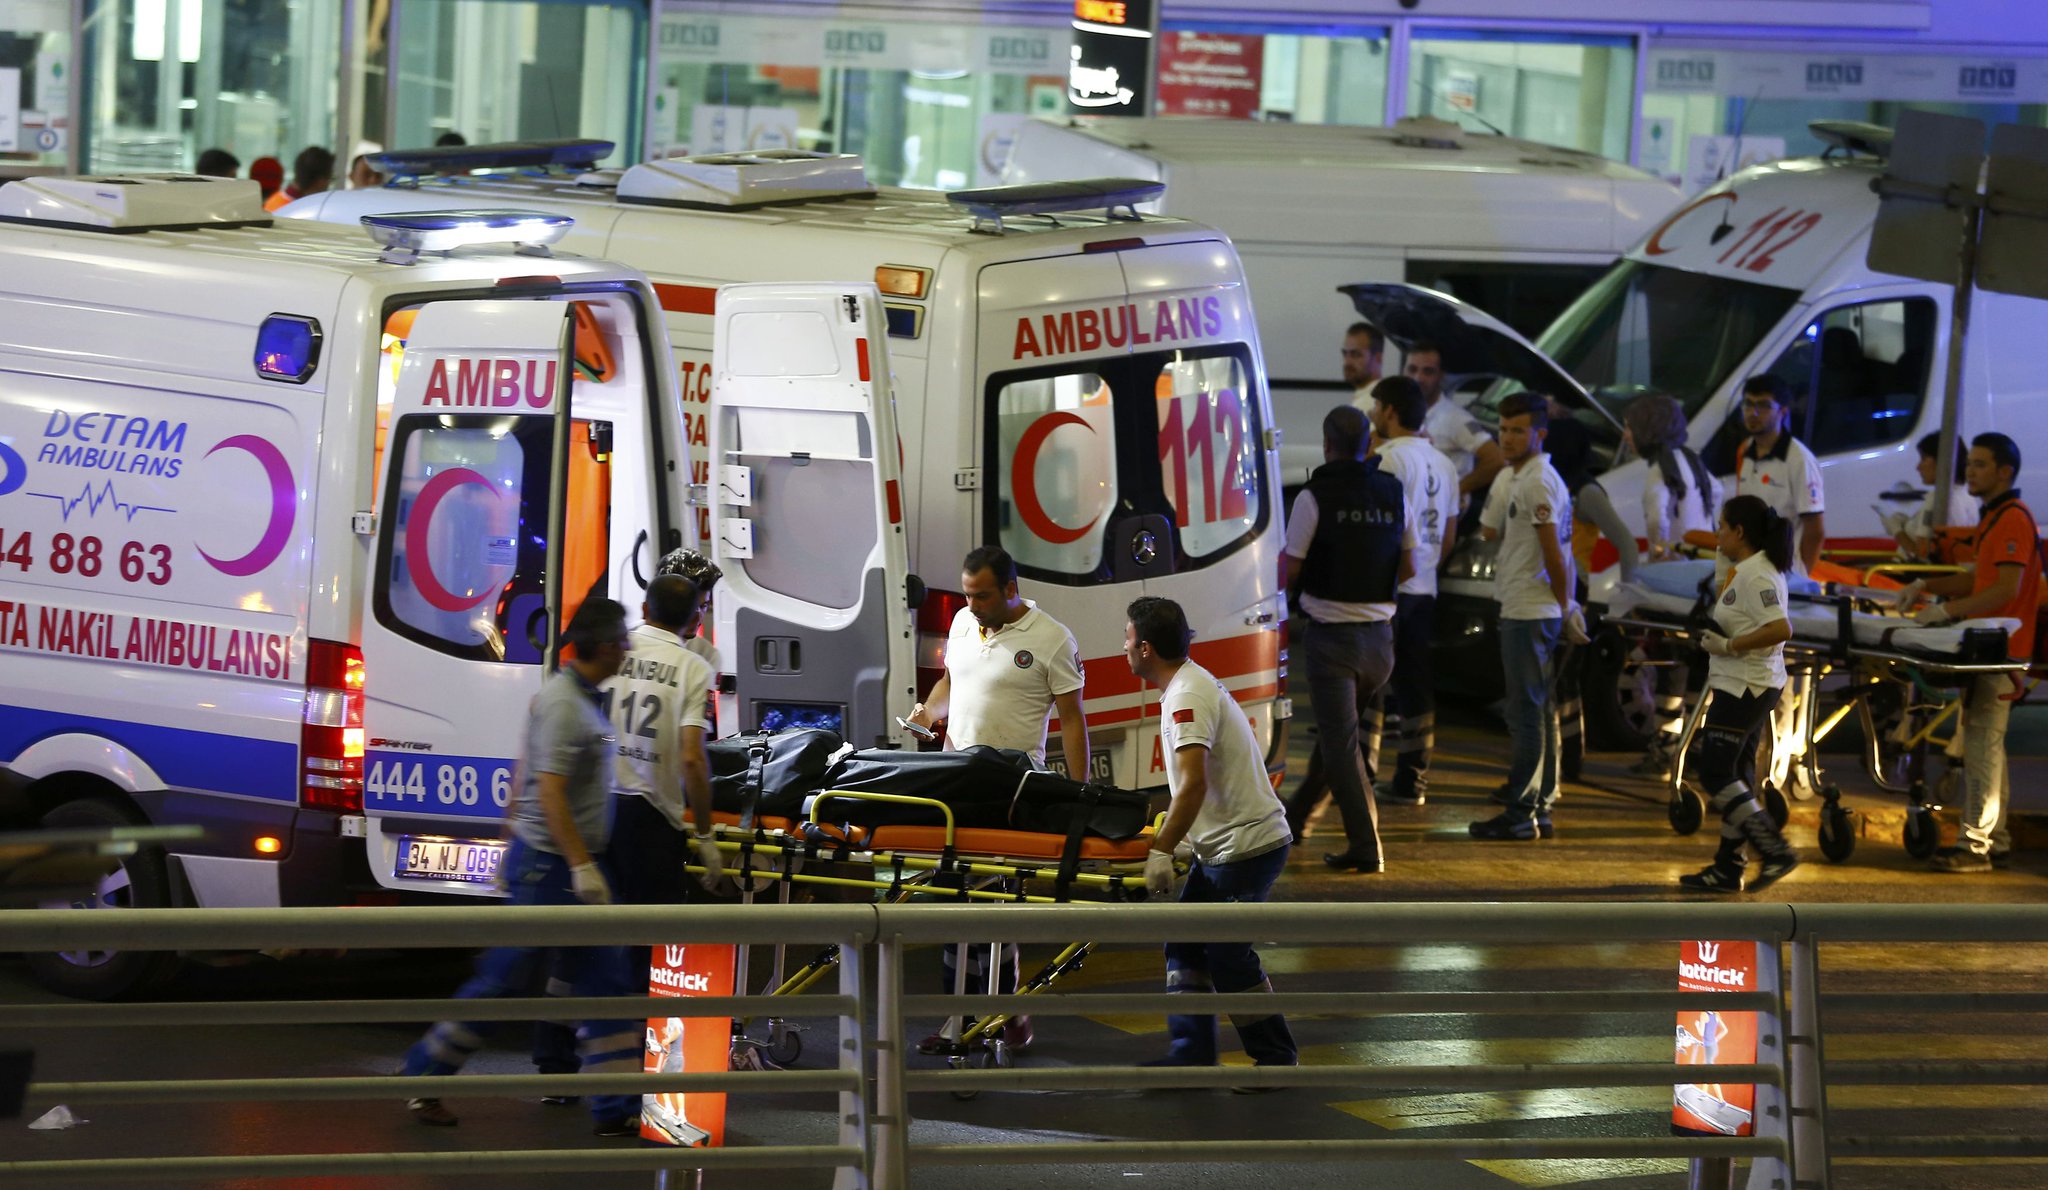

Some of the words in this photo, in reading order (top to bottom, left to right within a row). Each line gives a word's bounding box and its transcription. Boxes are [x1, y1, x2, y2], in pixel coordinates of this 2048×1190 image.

[1716, 206, 1822, 273] 112
[1013, 296, 1222, 360] AMBULANS
[422, 358, 557, 409] AMBU
[43, 409, 188, 453] DETAM
[37, 442, 183, 478] AMBULANS
[1158, 388, 1248, 528] 112
[0, 527, 33, 573] 4
[49, 532, 103, 577] 88
[119, 540, 173, 586] 63
[369, 738, 433, 751] SPRINTER
[367, 760, 426, 802] 444
[437, 764, 479, 806] 88
[409, 844, 429, 869] 34
[438, 846, 461, 871] NJ
